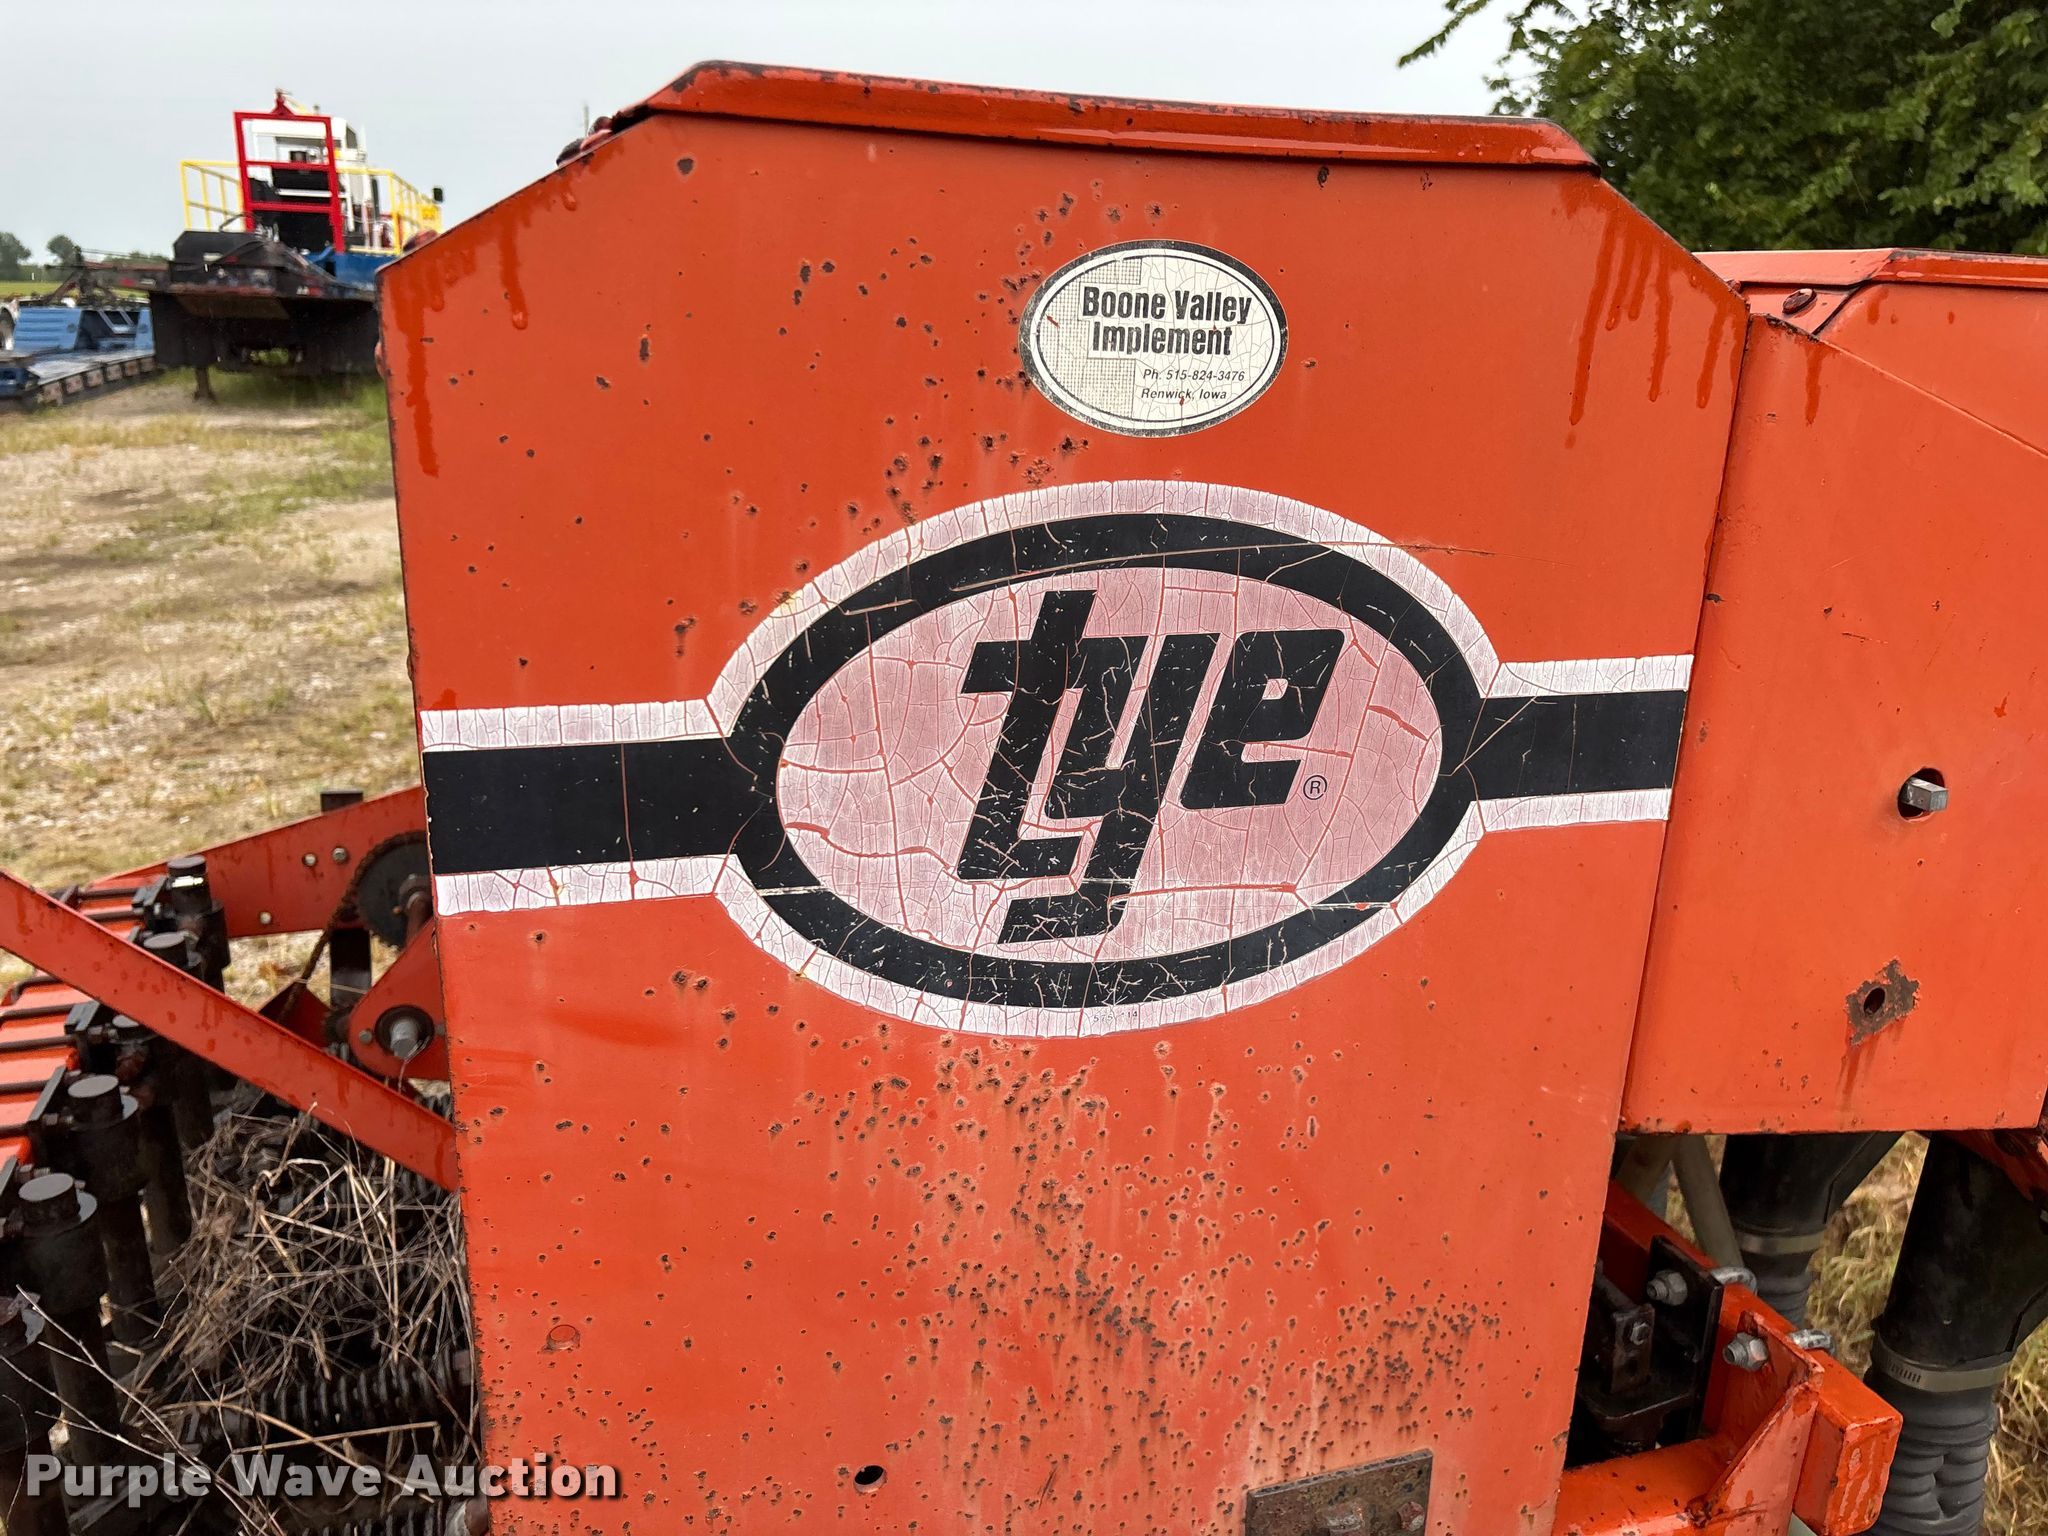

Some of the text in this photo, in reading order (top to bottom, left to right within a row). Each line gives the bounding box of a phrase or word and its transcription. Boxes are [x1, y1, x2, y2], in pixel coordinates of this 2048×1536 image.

[1082, 286, 1253, 325] Boone Valley
[1093, 322, 1233, 355] Implement
[1142, 368, 1246, 382] Ph. 515-824-3476
[1141, 388, 1227, 401] Renwick, Iowa
